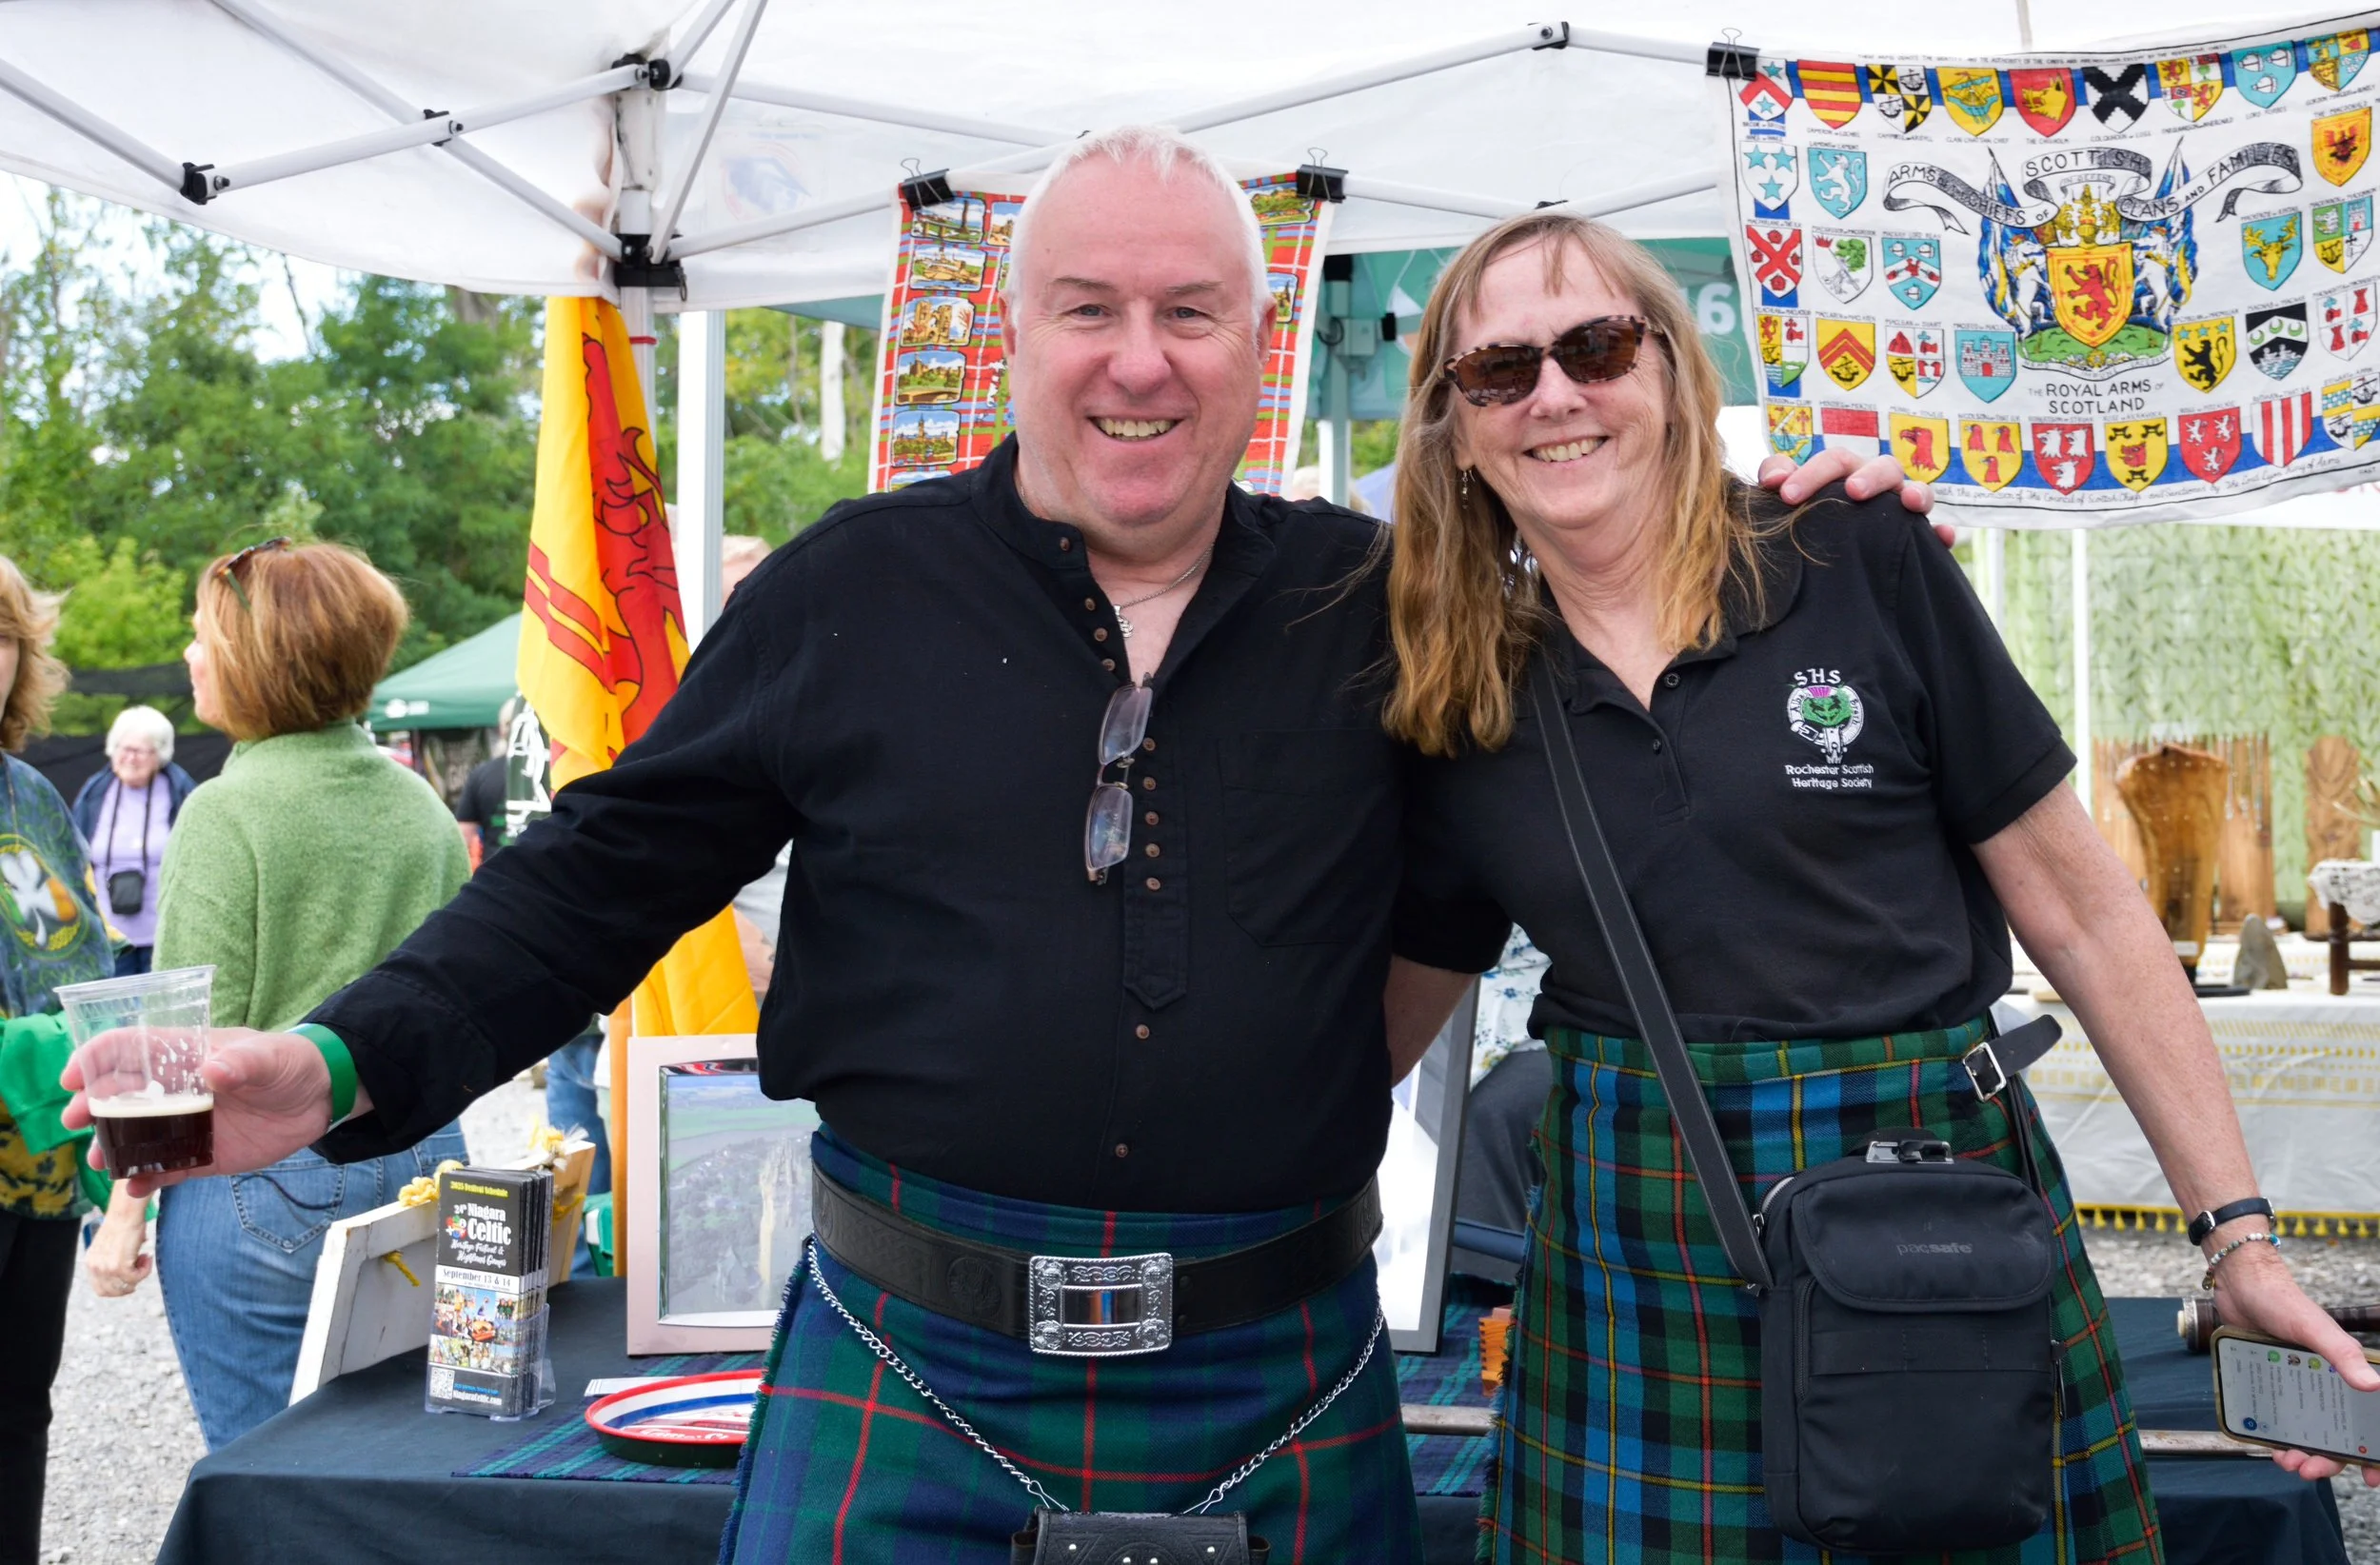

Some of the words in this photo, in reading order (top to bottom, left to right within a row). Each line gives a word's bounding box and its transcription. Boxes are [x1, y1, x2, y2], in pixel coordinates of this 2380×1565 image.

[2025, 149, 2143, 178] SCOTTISH
[2119, 195, 2180, 217] CLANS
[2185, 186, 2205, 203] AND
[2207, 148, 2295, 186] FAMILIES
[1888, 165, 1936, 188] ARMS
[1969, 190, 2026, 225] CHIEFS
[2035, 209, 2049, 222] OF
[2028, 387, 2043, 397] THE
[2047, 383, 2103, 397] ROYAL
[2108, 379, 2152, 394] ARMS
[2049, 397, 2145, 414] SCOTLAND
[1794, 667, 1841, 686] SHS
[1784, 764, 1839, 776] Rochester
[1841, 763, 1874, 775] Scottish
[1791, 778, 1838, 790] Heritage
[1840, 778, 1873, 788] Society
[467, 1202, 506, 1221] Niagara
[467, 1217, 512, 1245] Celtic
[1896, 1242, 1973, 1256] pacsafe
[443, 1269, 481, 1282] September
[484, 1274, 492, 1283] 13
[503, 1278, 511, 1287] 14
